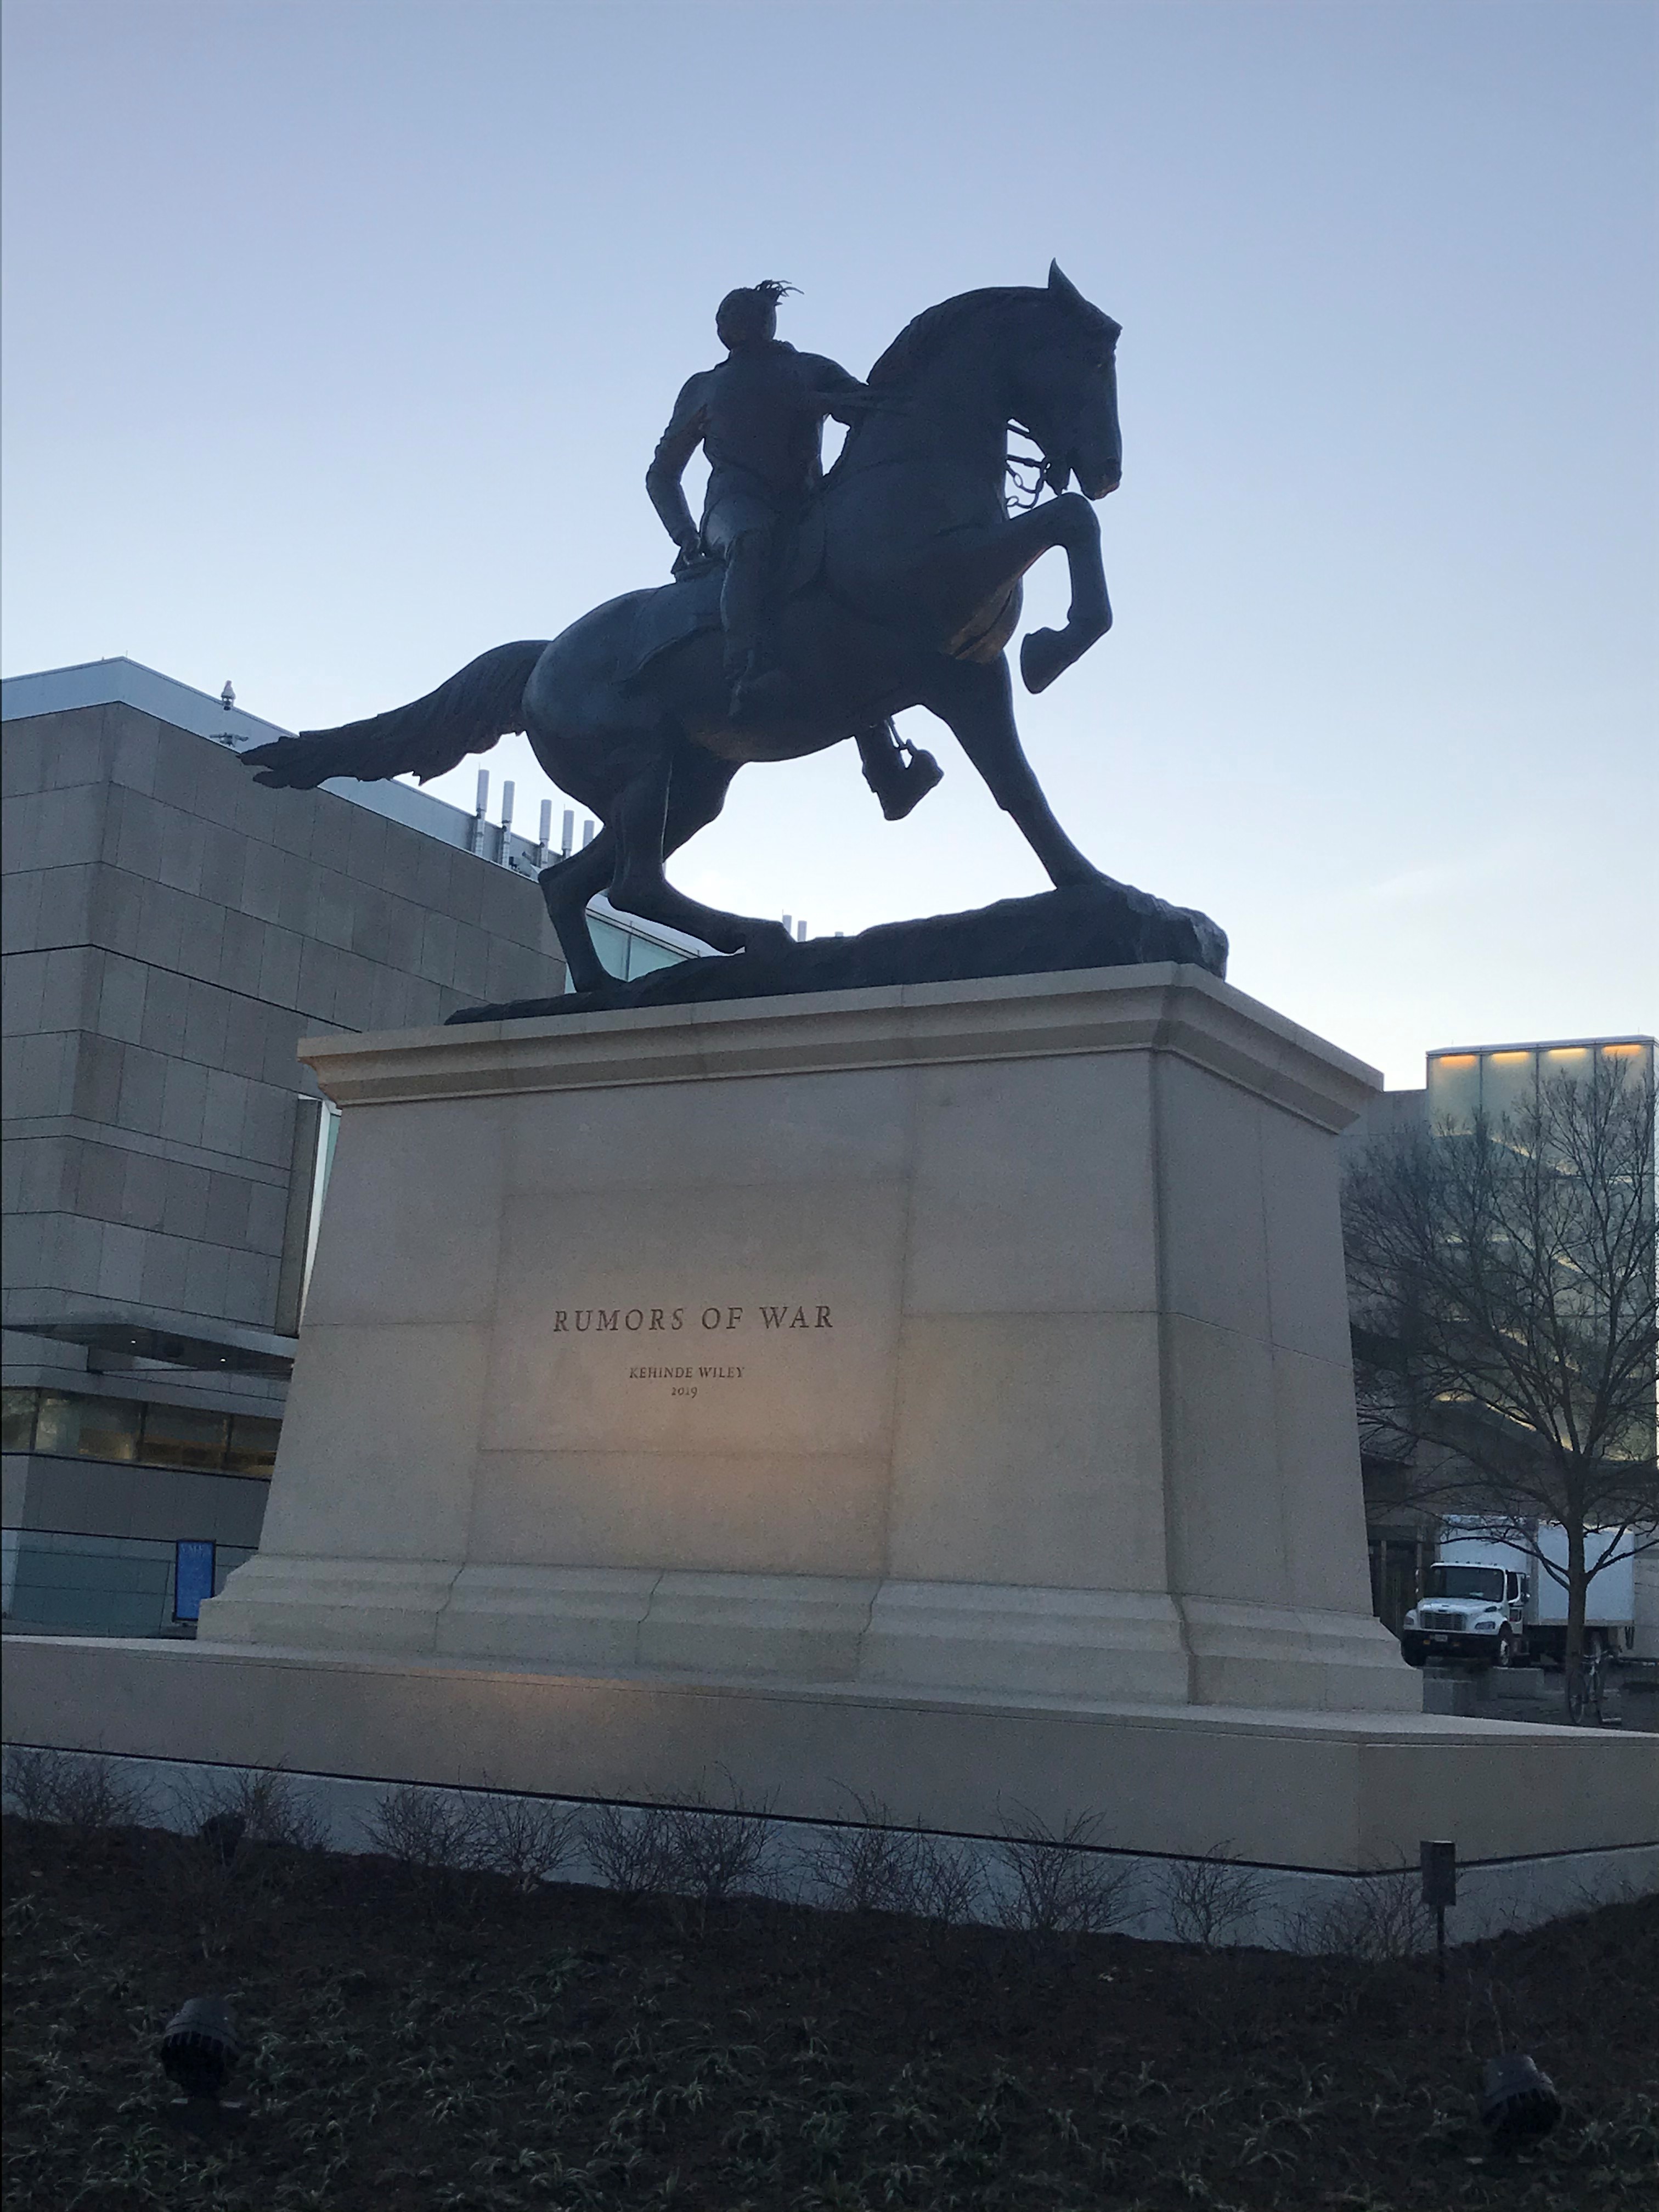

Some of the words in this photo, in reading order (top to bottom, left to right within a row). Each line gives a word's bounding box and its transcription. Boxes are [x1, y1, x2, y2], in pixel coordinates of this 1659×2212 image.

[553, 1308, 685, 1332] RUMORS
[701, 1307, 744, 1330] OF
[760, 1305, 833, 1329] WAR
[629, 1367, 693, 1379] KEHINDE
[698, 1366, 745, 1378] WILEY
[671, 1386, 698, 1399] 2019
